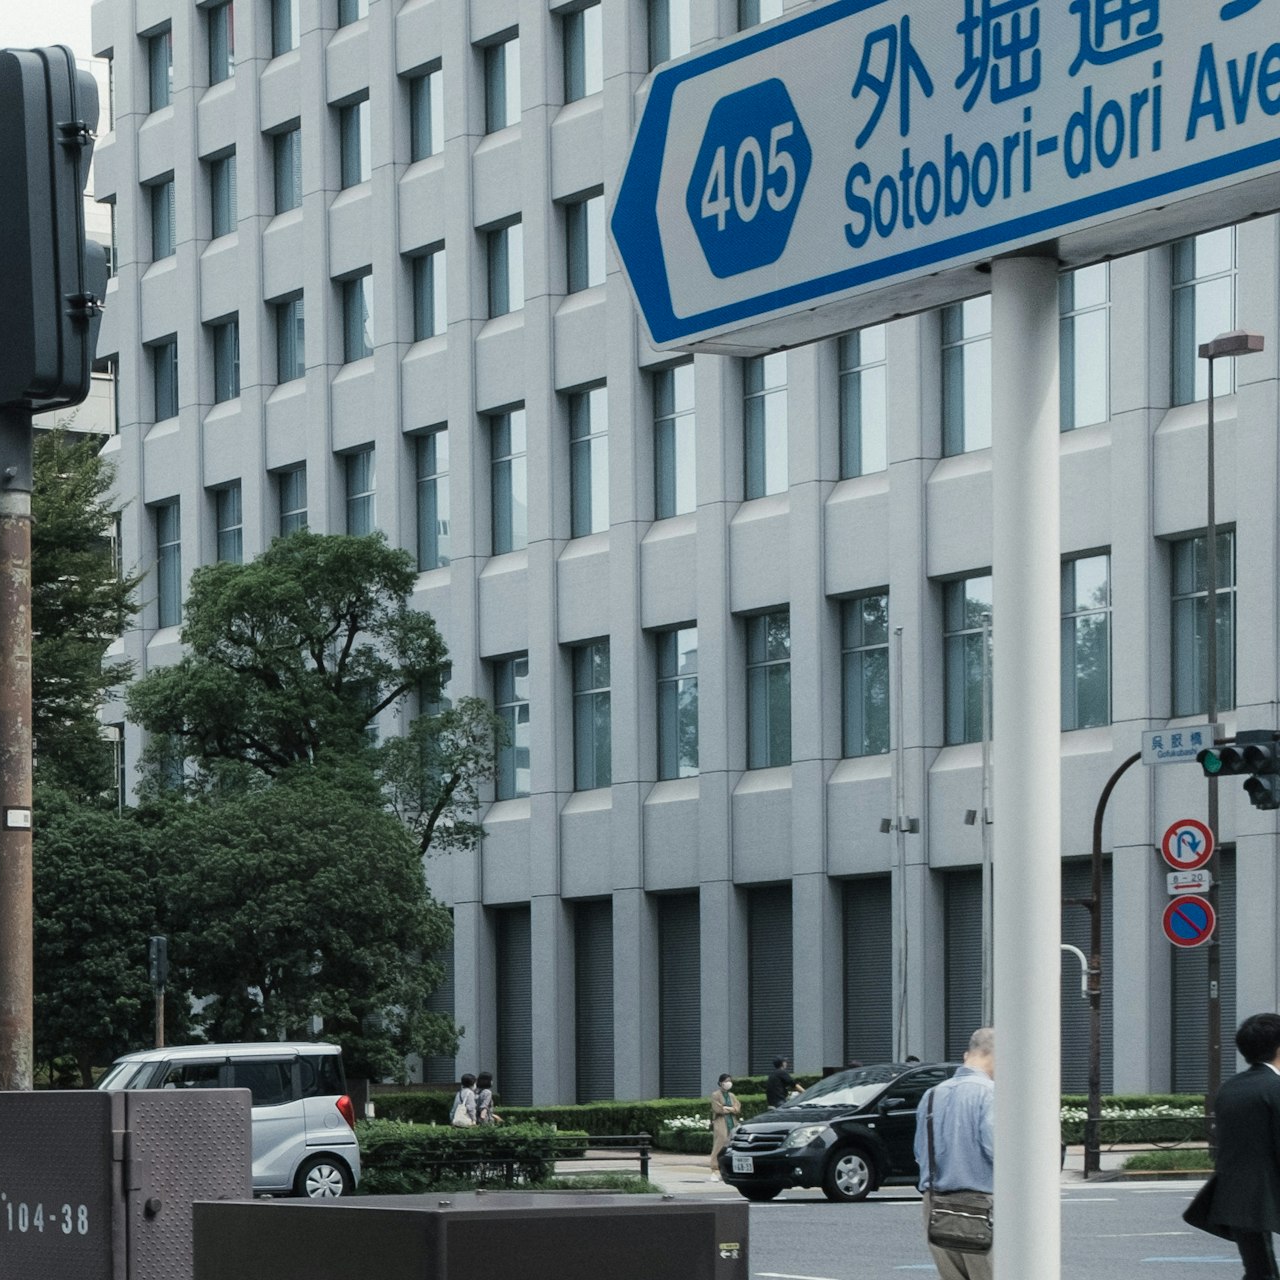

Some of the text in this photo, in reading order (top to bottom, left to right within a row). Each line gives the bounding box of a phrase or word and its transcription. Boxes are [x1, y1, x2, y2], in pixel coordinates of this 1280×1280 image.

[851, 0, 1262, 149] 外堀通
[700, 119, 797, 232] 405
[844, 60, 1162, 248] Sotobori-dori
[1152, 731, 1203, 751] 呉服橋
[7, 1202, 89, 1235] 104-38
